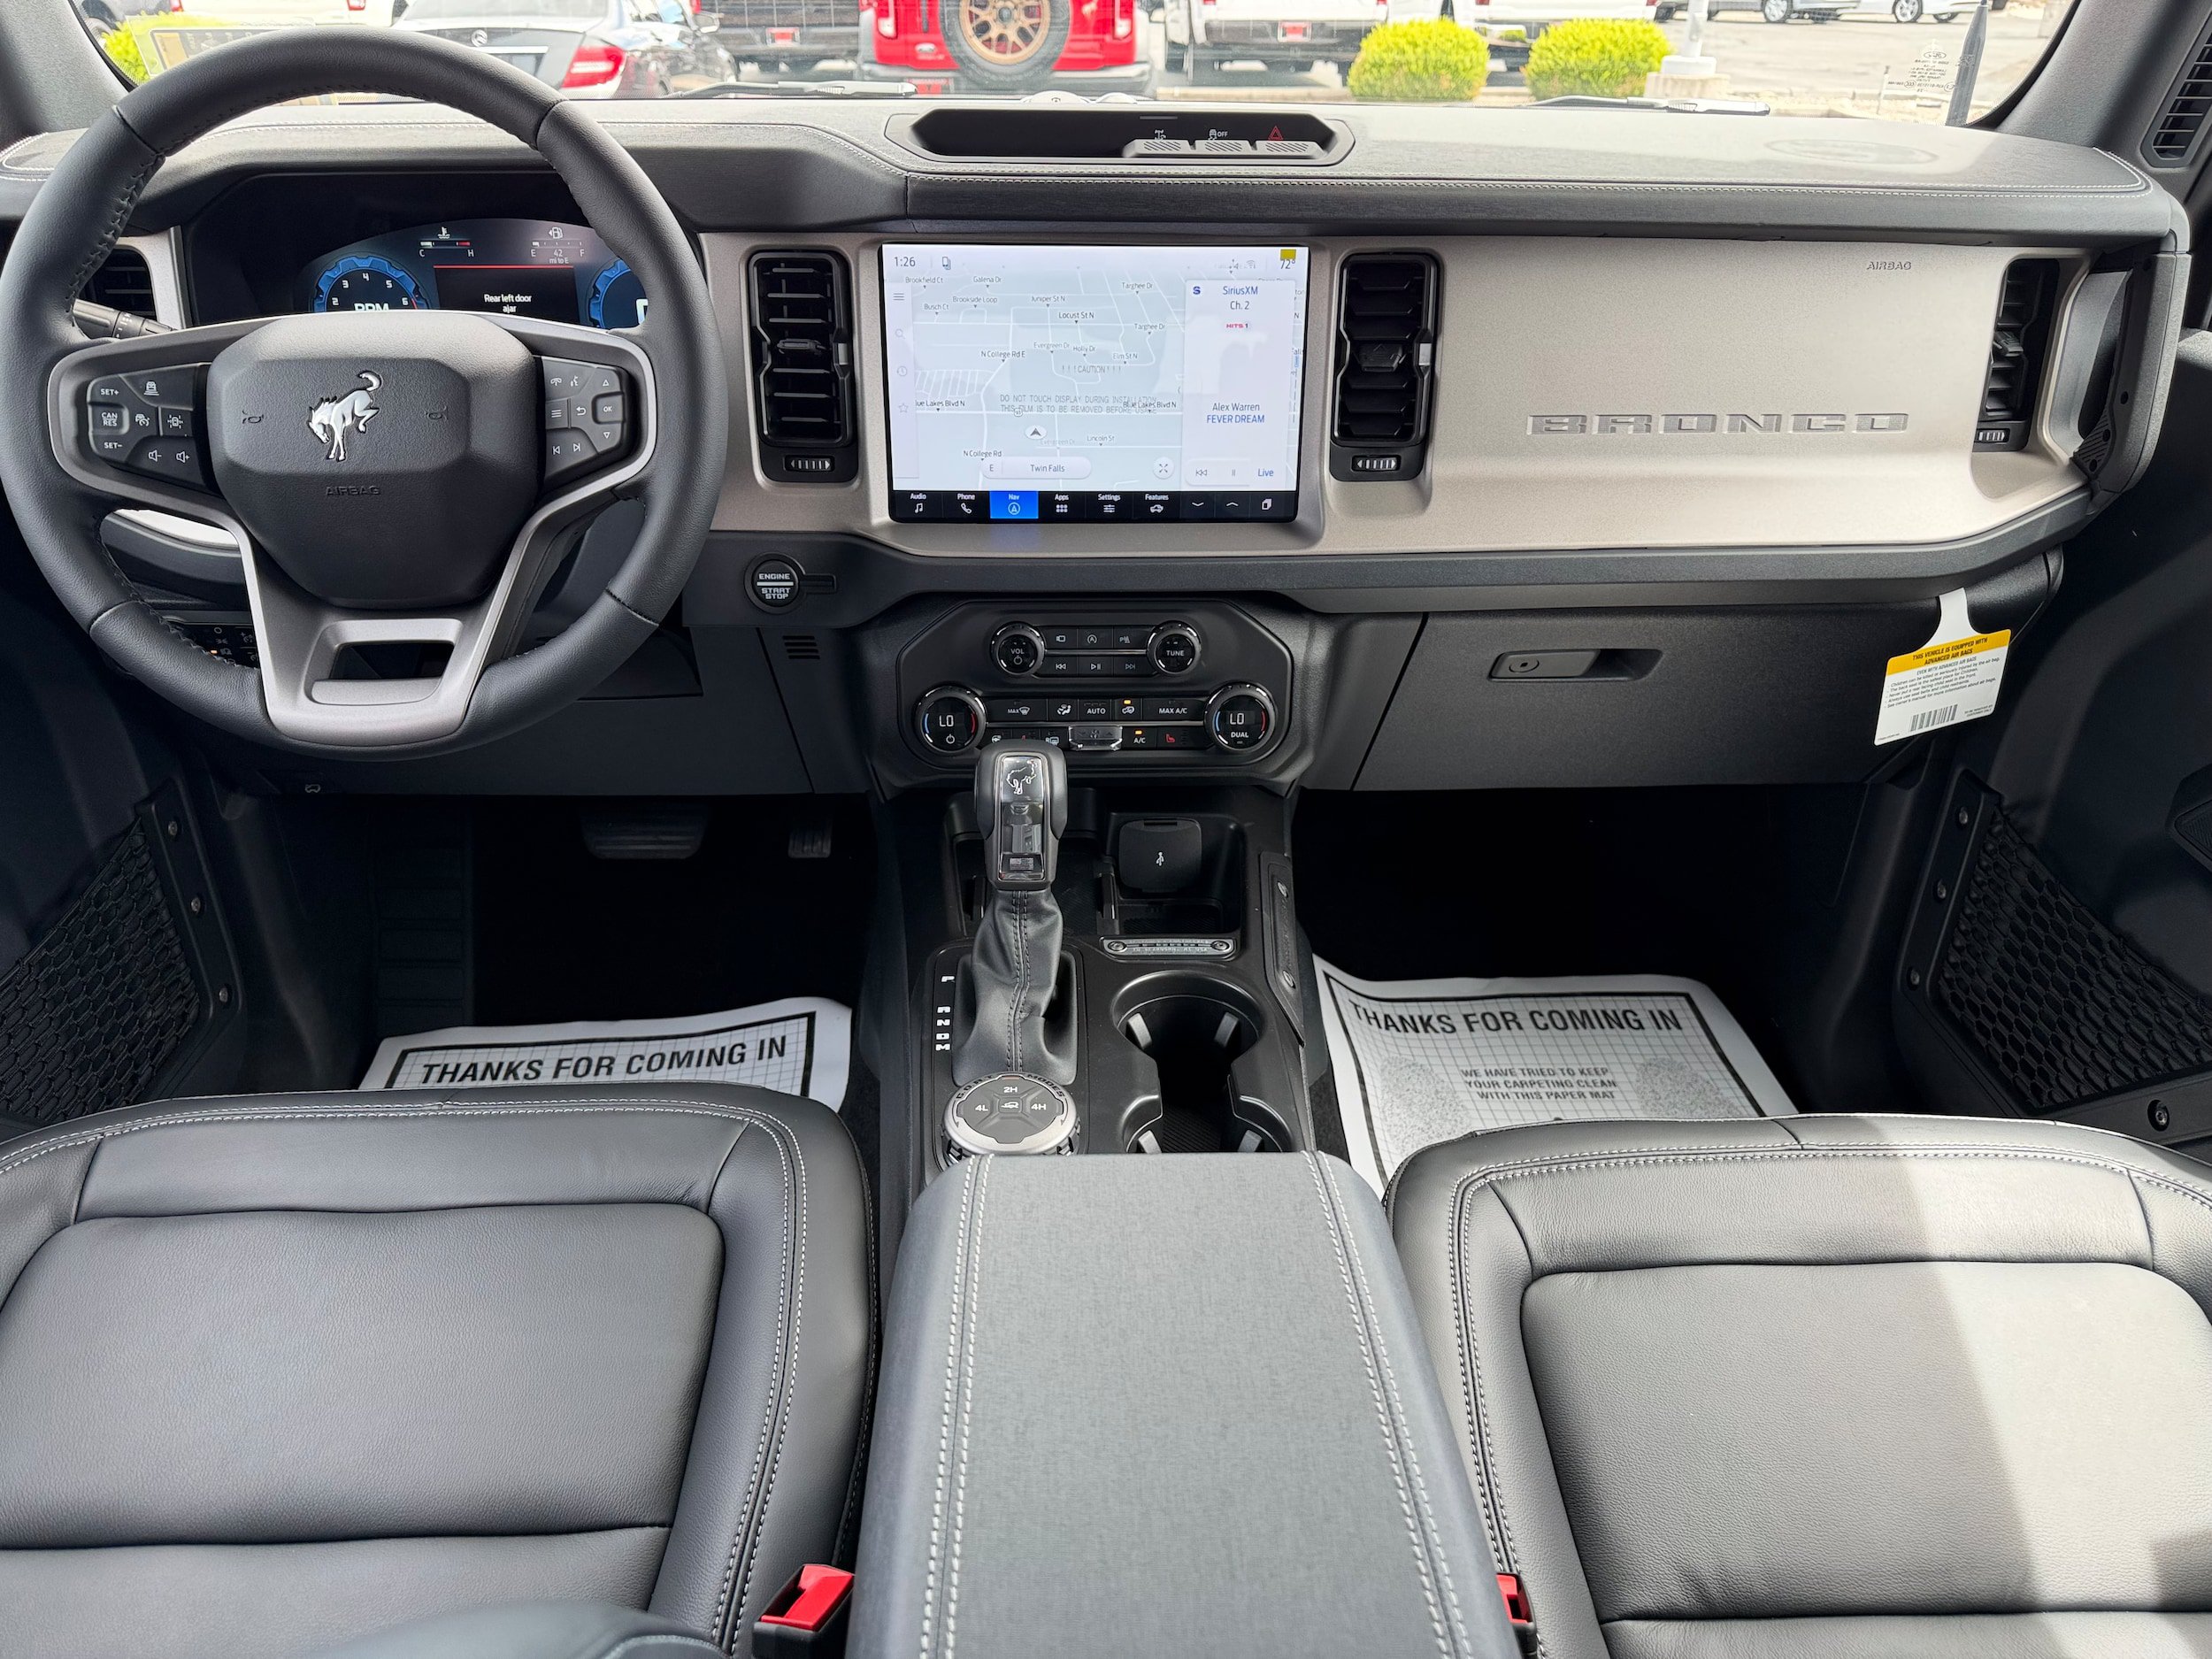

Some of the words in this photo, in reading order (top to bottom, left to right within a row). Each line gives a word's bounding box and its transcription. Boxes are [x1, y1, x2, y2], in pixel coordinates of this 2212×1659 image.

[894, 257, 916, 267] 1:26
[1866, 261, 1912, 271] AIRBAG
[363, 273, 369, 281] 4
[342, 280, 349, 288] 3
[386, 280, 393, 288] 5
[1222, 286, 1258, 296] SiriusXM
[484, 294, 501, 303] Rear
[502, 294, 514, 303] left
[515, 294, 532, 303] door
[503, 304, 517, 314] ajar
[1230, 301, 1243, 311] Ch.
[1244, 301, 1250, 311] 2
[987, 350, 1010, 359] College
[1212, 403, 1230, 411] Alex
[1231, 403, 1260, 411] Warren
[1206, 414, 1233, 424] FEVER
[1234, 414, 1265, 424] DREAM
[1526, 413, 1909, 435] BRONCO
[969, 450, 992, 459] College
[326, 486, 380, 496] AIRBAG
[1055, 494, 1069, 503] Apps
[1924, 648, 1944, 657] VEHICLE
[1950, 641, 1974, 650] EQUIPPED
[1924, 654, 1950, 664] ADVANCED
[939, 714, 955, 727] LO
[1229, 713, 1245, 726] LO
[1348, 999, 1456, 1035] THANKS
[1463, 1010, 1523, 1033] FOR
[1529, 1009, 1645, 1033] COMING
[1647, 1009, 1682, 1032] IN
[420, 1059, 541, 1086] THANKS
[552, 1055, 617, 1079] FOR
[626, 1042, 746, 1076] COMING
[757, 1035, 787, 1061] IN
[1460, 1068, 1484, 1078] WE
[1485, 1068, 1517, 1078] HAVE
[1519, 1068, 1555, 1078] TRIED
[1560, 1068, 1575, 1078] TO
[1578, 1068, 1609, 1078] KEEP
[1027, 1073, 1065, 1097] MODES
[1465, 1079, 1500, 1089] YOUR
[1504, 1079, 1575, 1089] CARPETING
[1576, 1079, 1617, 1089] CLEAN
[1477, 1091, 1511, 1100] WITH
[1515, 1091, 1543, 1100] THIS
[1547, 1091, 1586, 1100] PAPER
[1589, 1091, 1617, 1100] MAT
